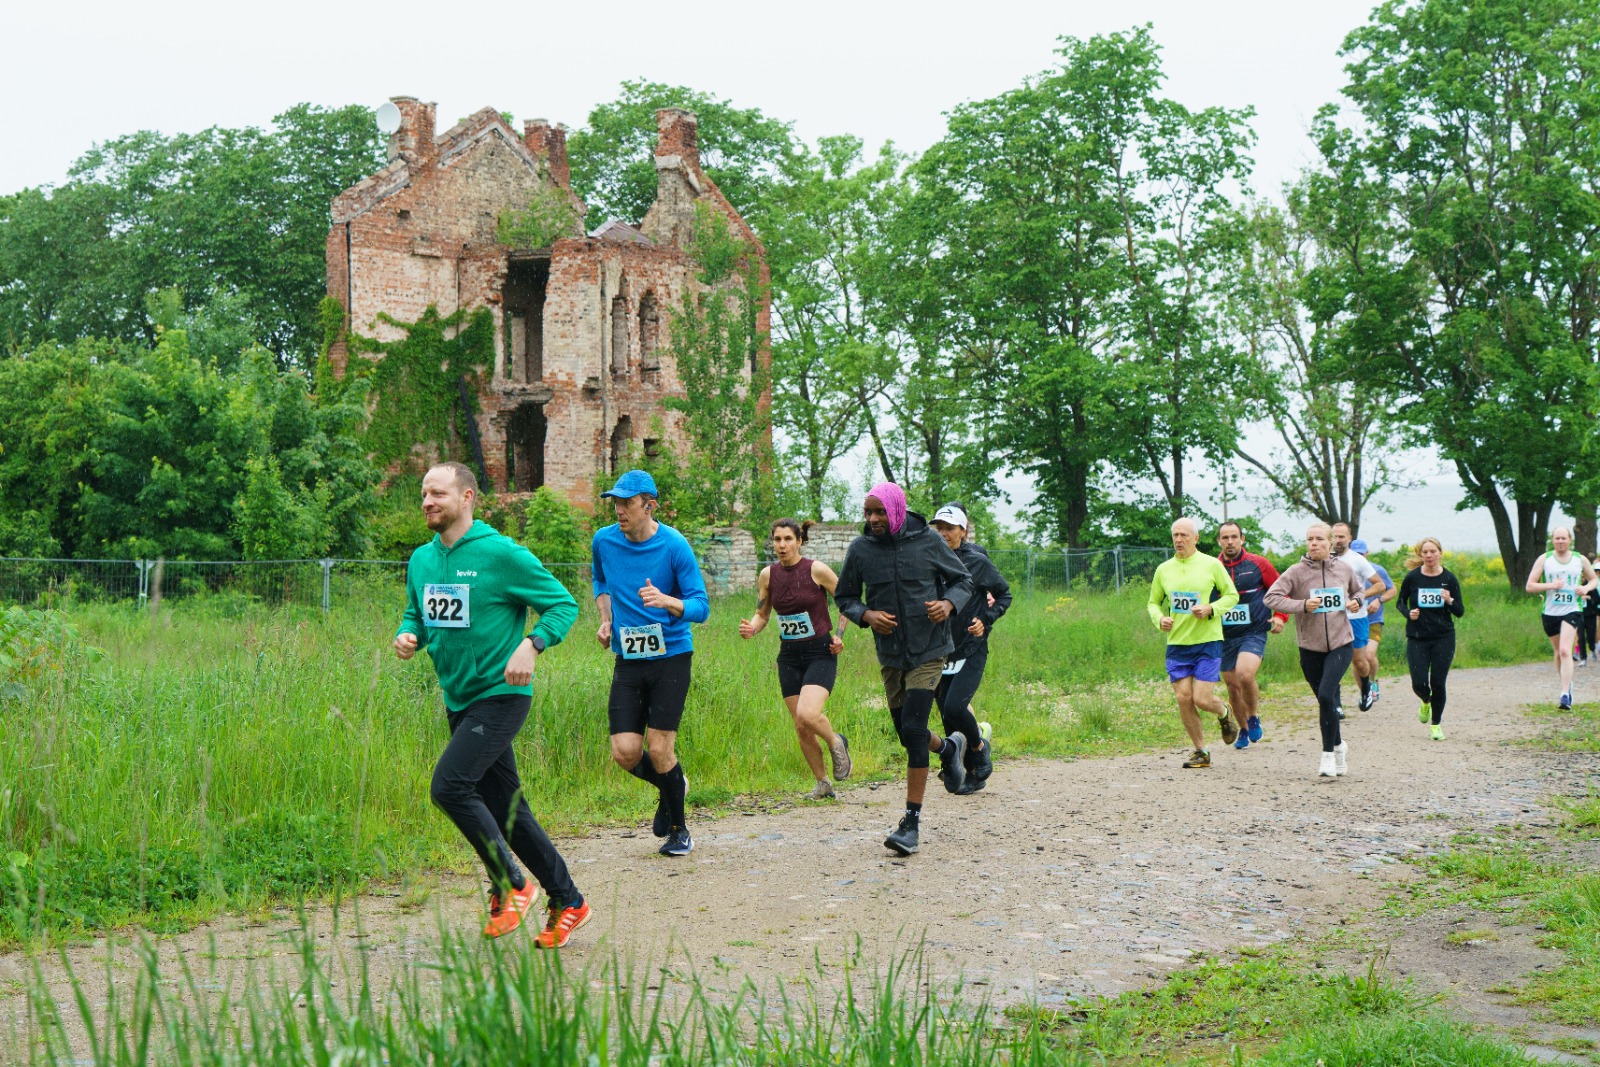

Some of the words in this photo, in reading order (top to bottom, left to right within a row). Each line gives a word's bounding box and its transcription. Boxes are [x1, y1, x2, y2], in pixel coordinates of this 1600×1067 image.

[1421, 594, 1442, 605] 339
[1554, 593, 1573, 603] 219
[427, 598, 463, 621] 322
[1224, 610, 1247, 622] 208
[781, 621, 809, 636] 225
[624, 635, 660, 654] 279
